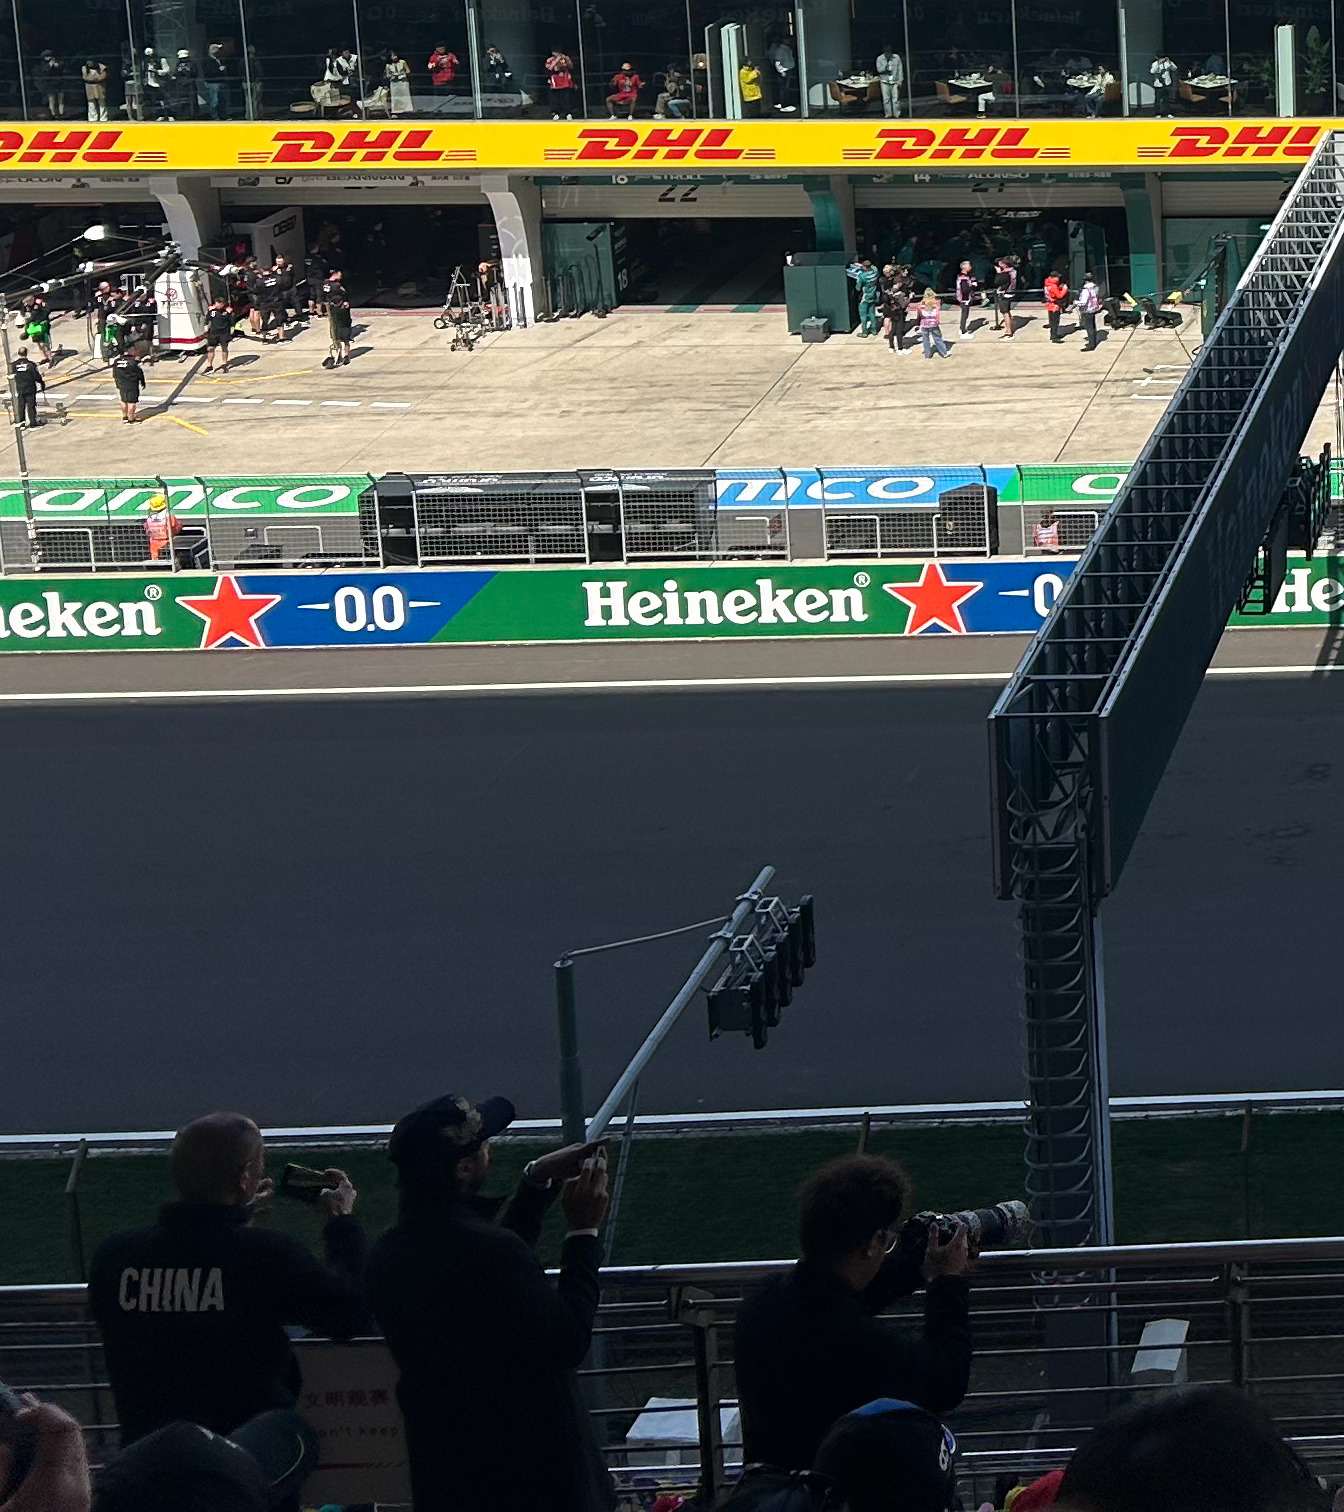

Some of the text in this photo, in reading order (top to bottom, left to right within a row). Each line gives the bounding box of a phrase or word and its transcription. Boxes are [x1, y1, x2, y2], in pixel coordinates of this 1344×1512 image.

[271, 130, 445, 163] DHL
[576, 128, 745, 160] DHL
[874, 128, 1041, 160] DHL
[713, 476, 935, 502] mco
[335, 586, 405, 632] 0.0
[118, 1266, 225, 1312] CHINA
[360, 1426, 398, 1437] keep
